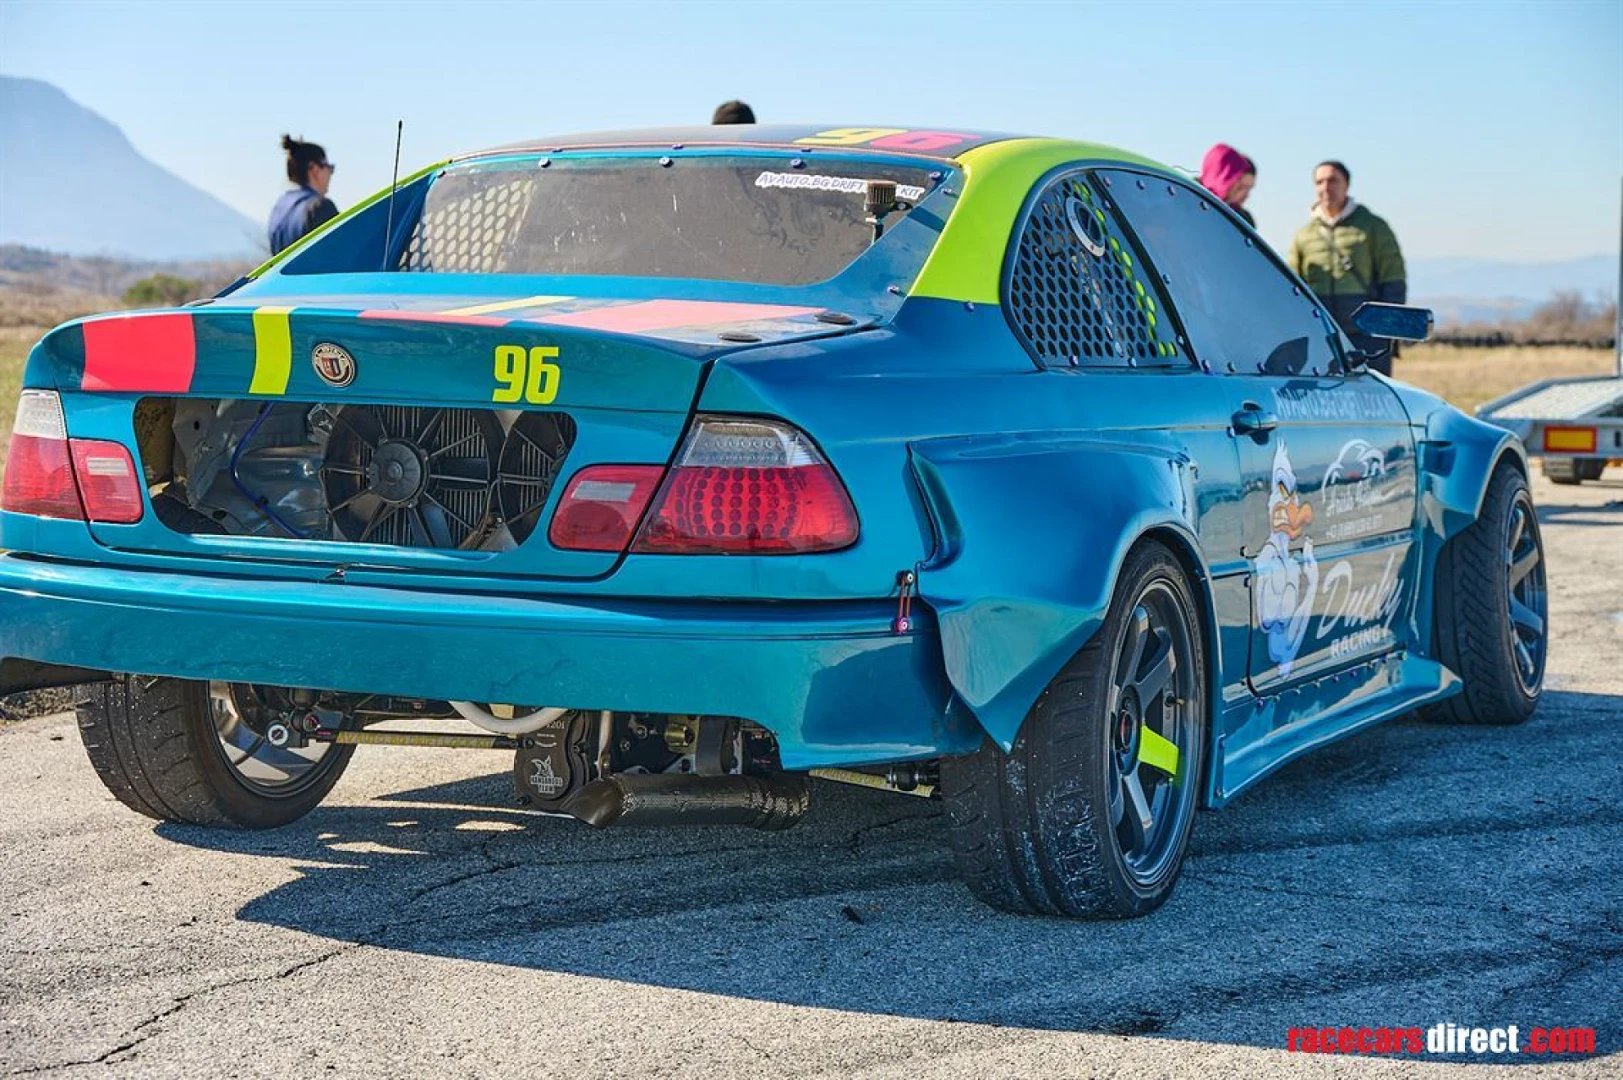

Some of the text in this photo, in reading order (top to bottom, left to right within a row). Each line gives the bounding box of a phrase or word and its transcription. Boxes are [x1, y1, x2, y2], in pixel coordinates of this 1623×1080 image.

[792, 128, 981, 150] 96
[830, 179, 865, 191] DRIFT
[900, 187, 921, 198] KIT
[492, 345, 561, 405] 96
[1331, 624, 1382, 659] RACING
